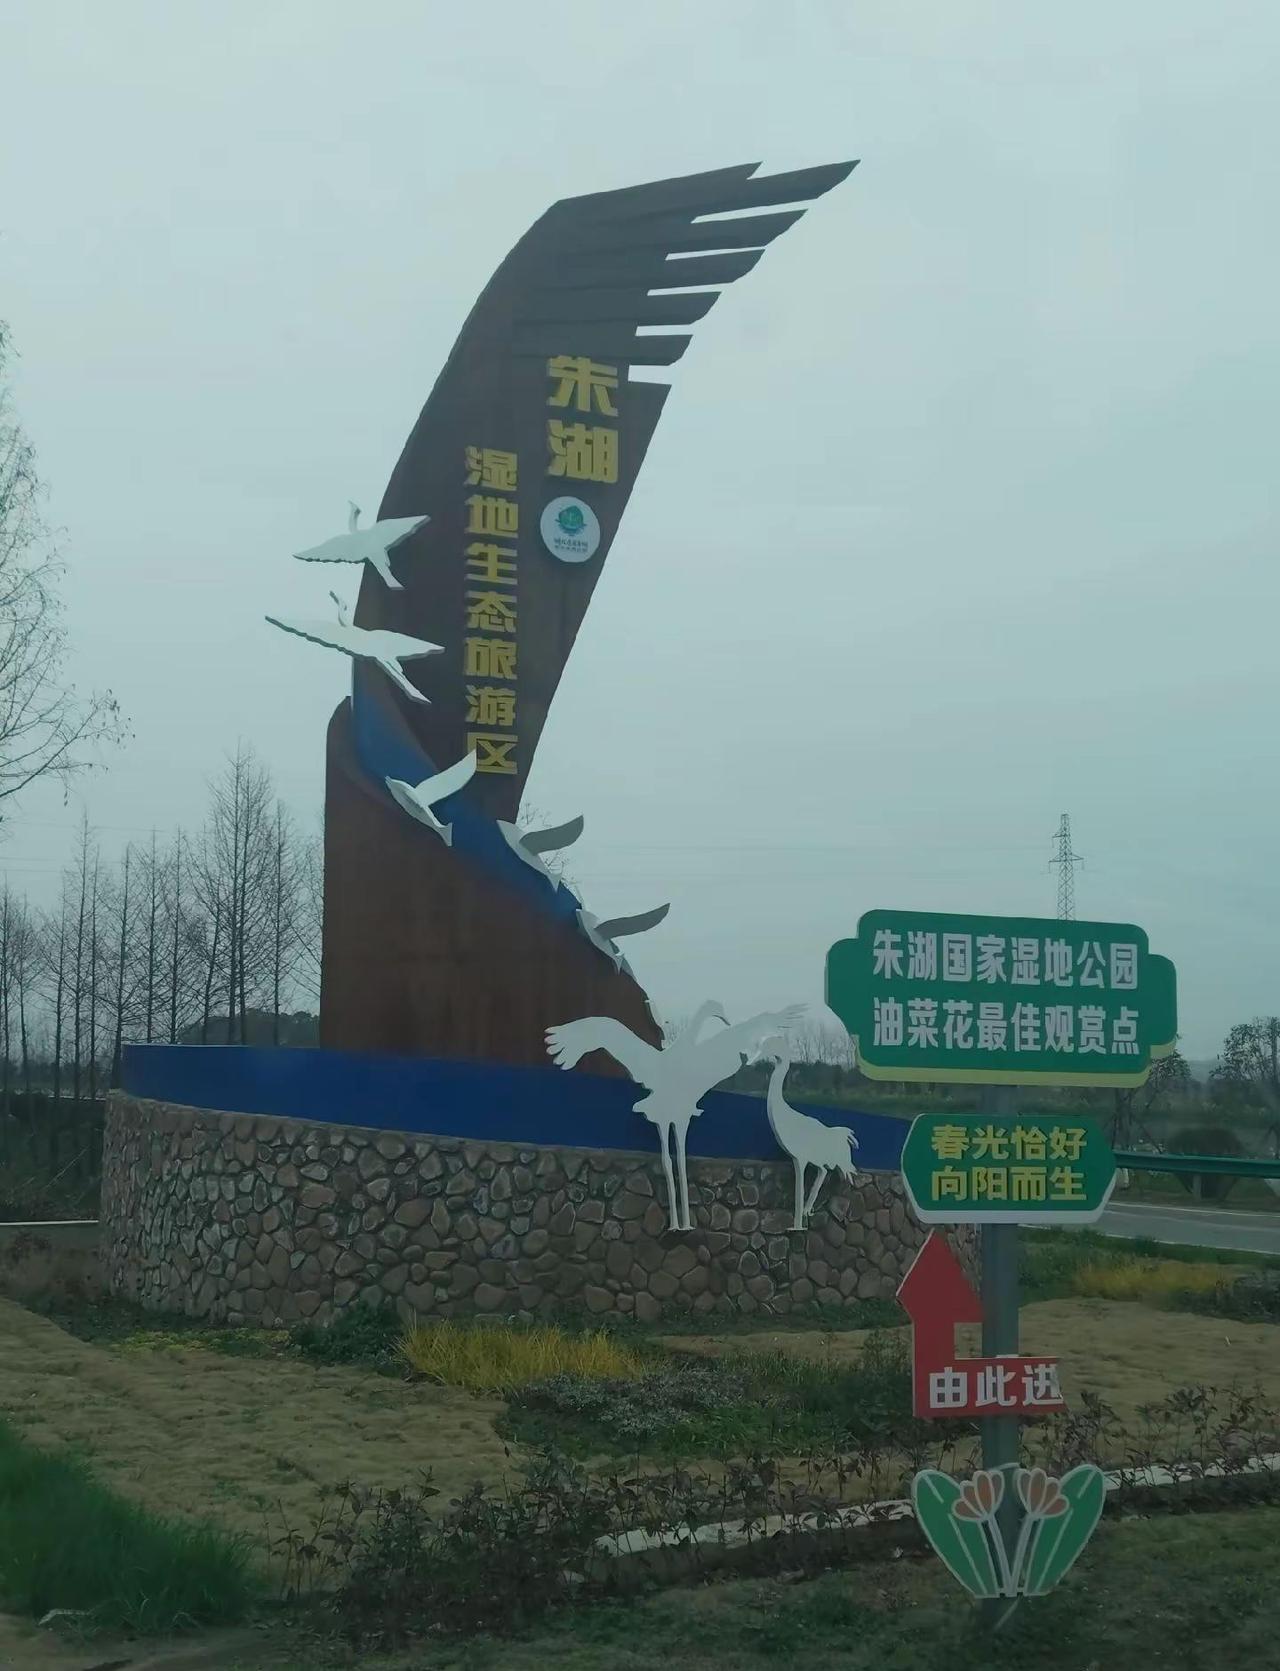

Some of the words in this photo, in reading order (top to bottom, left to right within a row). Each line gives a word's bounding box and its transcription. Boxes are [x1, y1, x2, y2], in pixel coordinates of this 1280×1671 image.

[547, 355, 619, 484] 朱湖
[464, 446, 519, 775] 湿地生态旅游区
[872, 929, 1139, 990] 朱湖国家湿地公园
[872, 996, 1140, 1055] 油菜花最佳观赏点
[931, 1125, 1088, 1161] 春光恰好
[931, 1165, 1088, 1202] 向阳而生
[929, 1364, 1064, 1409] 由此进
